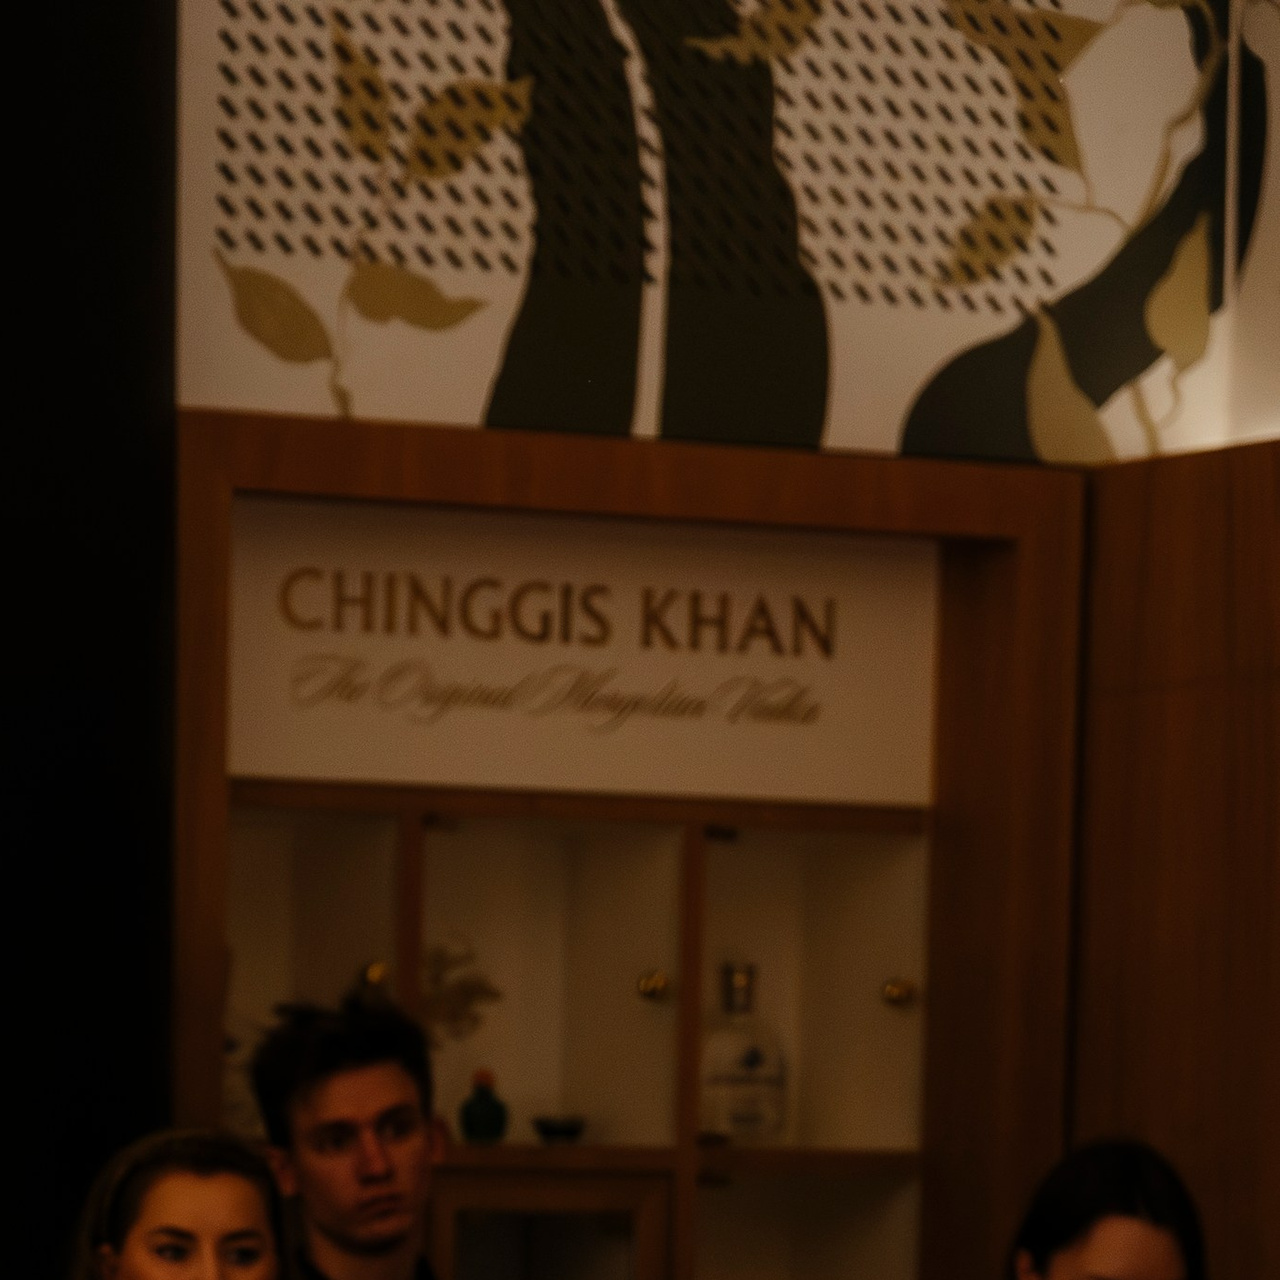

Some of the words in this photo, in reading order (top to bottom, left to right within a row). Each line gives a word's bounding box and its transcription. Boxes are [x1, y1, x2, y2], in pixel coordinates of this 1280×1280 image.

[278, 567, 613, 648] CHINGGIS
[639, 586, 837, 661] KHAN
[290, 652, 369, 711] The
